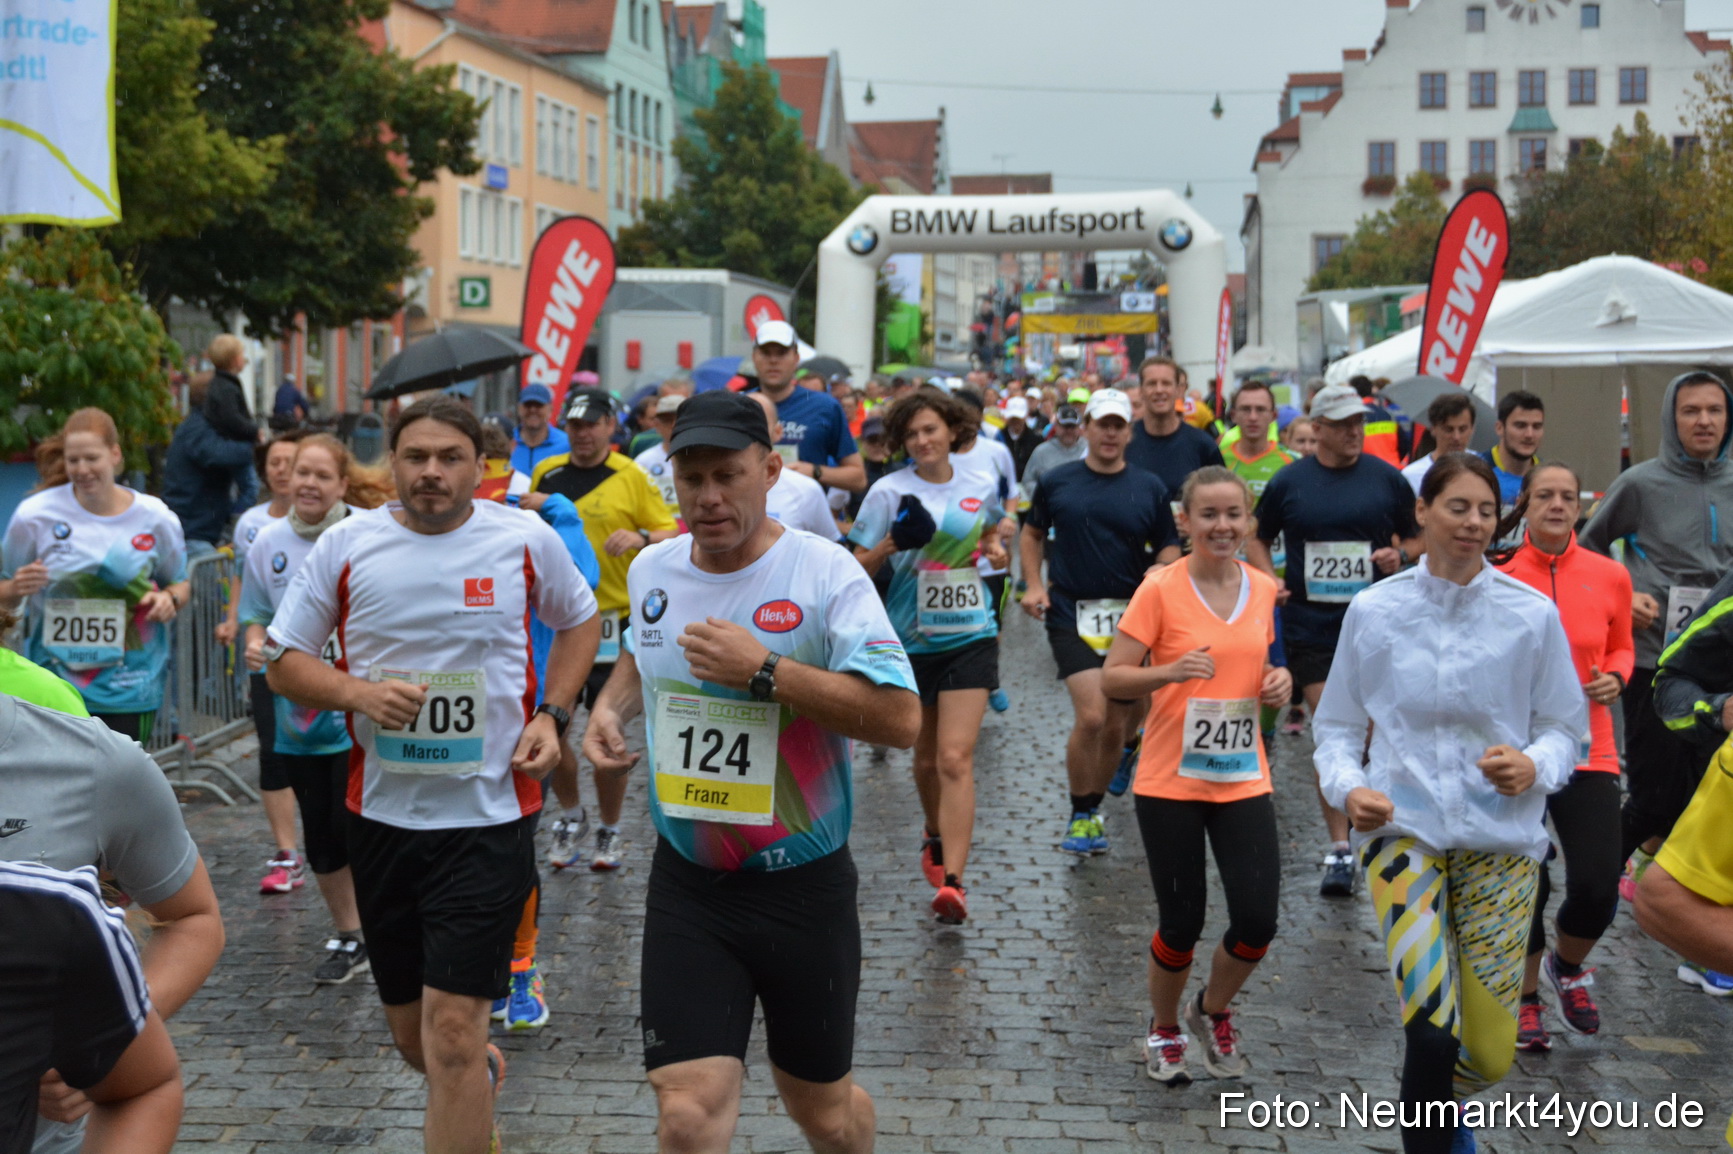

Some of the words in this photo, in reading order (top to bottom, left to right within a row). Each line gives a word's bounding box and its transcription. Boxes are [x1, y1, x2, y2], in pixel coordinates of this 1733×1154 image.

[890, 208, 977, 235] BMW
[988, 206, 1145, 238] Laufsport
[462, 280, 487, 305] D
[1425, 215, 1498, 382] REWE
[526, 238, 602, 397] REWE
[1312, 557, 1366, 579] 2234
[466, 595, 493, 604] DKMS
[926, 584, 979, 609] 2863
[760, 607, 798, 625] Hervis
[52, 616, 117, 643] 2055
[666, 706, 701, 717] NeuerMarkt
[707, 701, 768, 722] BOCK
[1193, 718, 1254, 750] 2473
[402, 743, 450, 760] Marco
[677, 725, 751, 777] 124
[684, 783, 730, 805] Franz
[4, 818, 28, 829] NIKE
